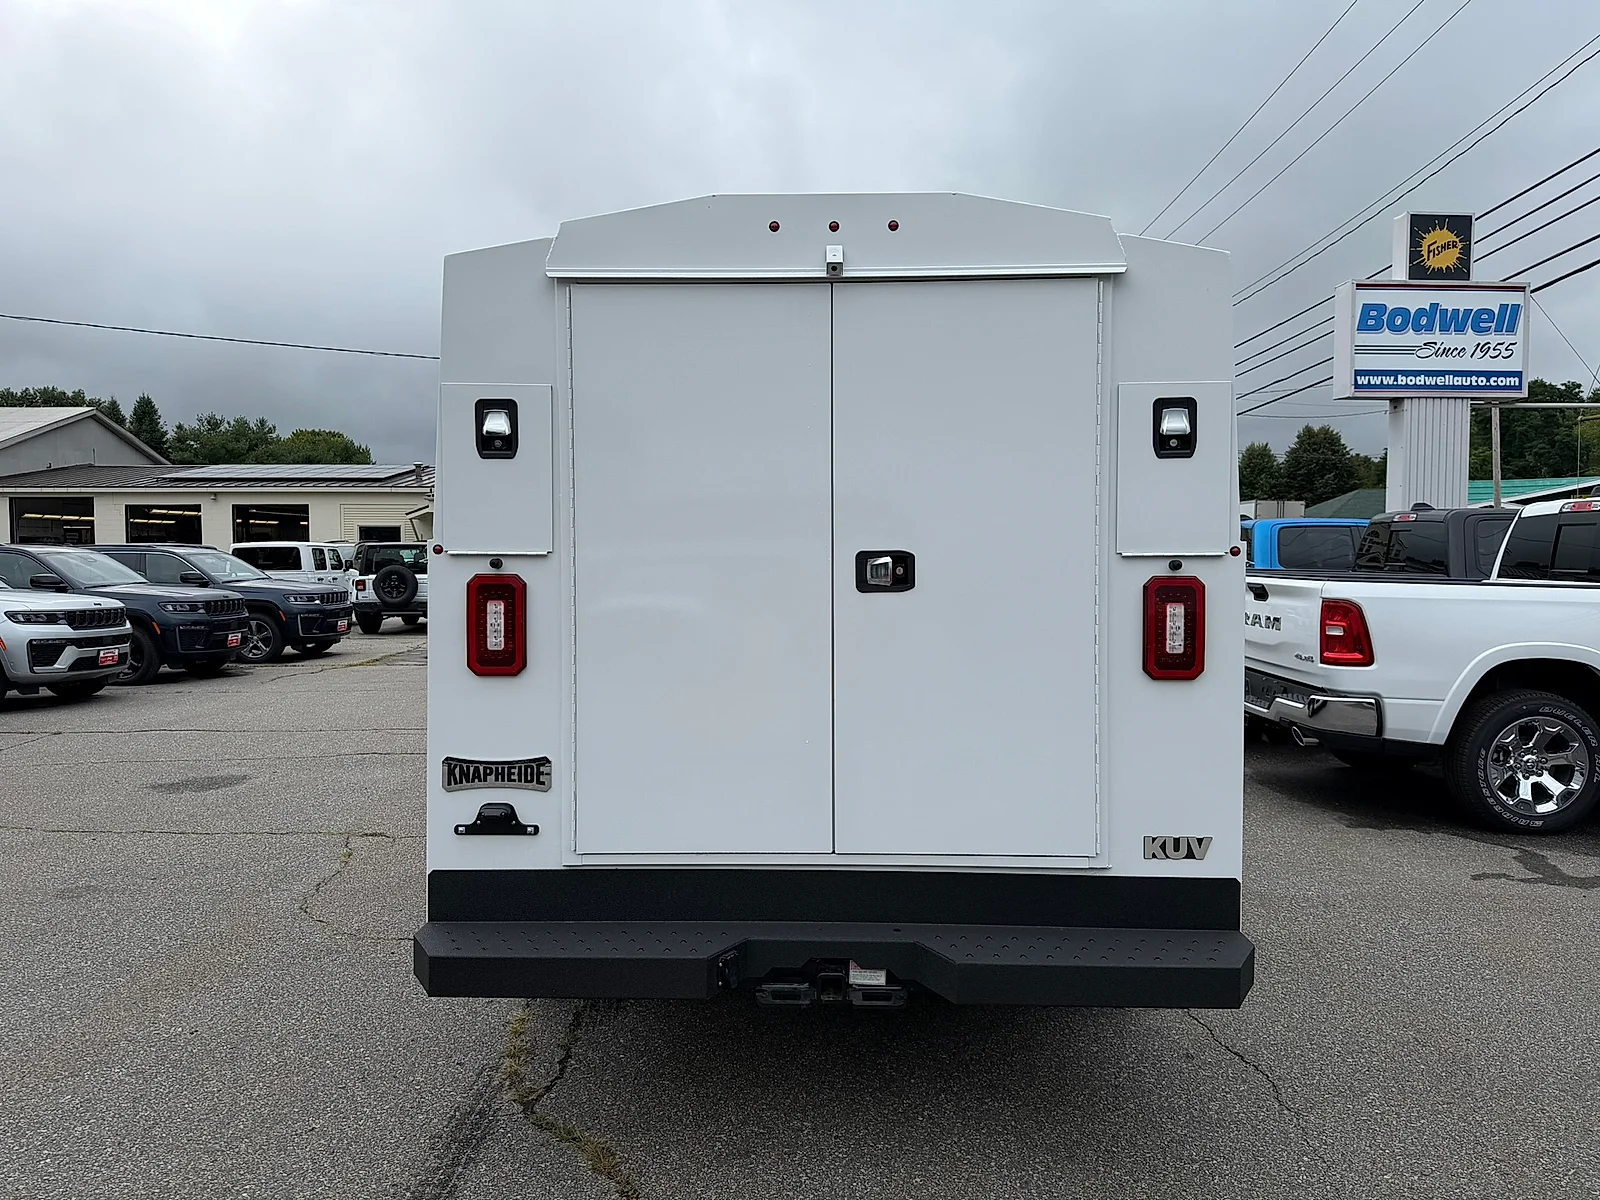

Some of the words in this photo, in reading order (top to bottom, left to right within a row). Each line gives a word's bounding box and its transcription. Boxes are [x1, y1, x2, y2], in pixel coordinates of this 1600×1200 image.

[1426, 239, 1460, 261] FISHER
[1356, 302, 1522, 335] Bodwell
[1415, 341, 1467, 359] Since
[1470, 341, 1518, 360] 1955
[1356, 374, 1520, 386] www.bodwellauto.com
[446, 761, 547, 787] KNAPHEIDE
[1477, 747, 1544, 827] BRIDGESTONE
[1143, 835, 1213, 860] KUV
